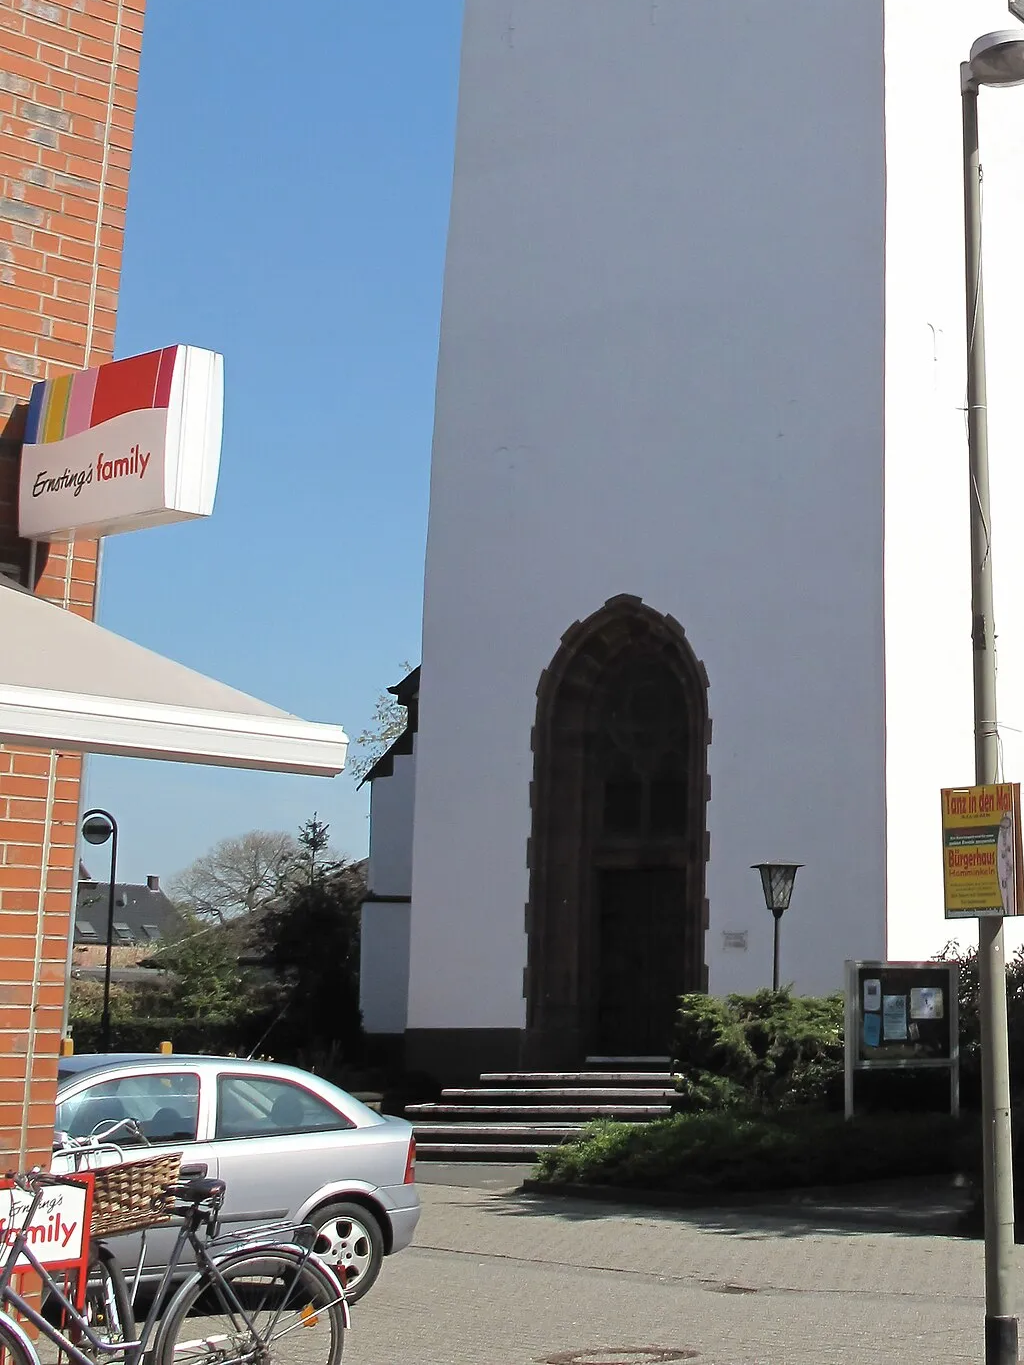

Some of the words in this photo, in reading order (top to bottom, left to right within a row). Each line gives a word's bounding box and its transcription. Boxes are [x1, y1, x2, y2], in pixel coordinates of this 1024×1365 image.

[32, 463, 94, 498] Ernsting's
[96, 444, 151, 482] family
[945, 789, 967, 815] Tanz
[969, 790, 977, 814] in
[979, 786, 994, 812] den
[996, 785, 1011, 811] Mai
[948, 847, 995, 870] Bürgerhaus
